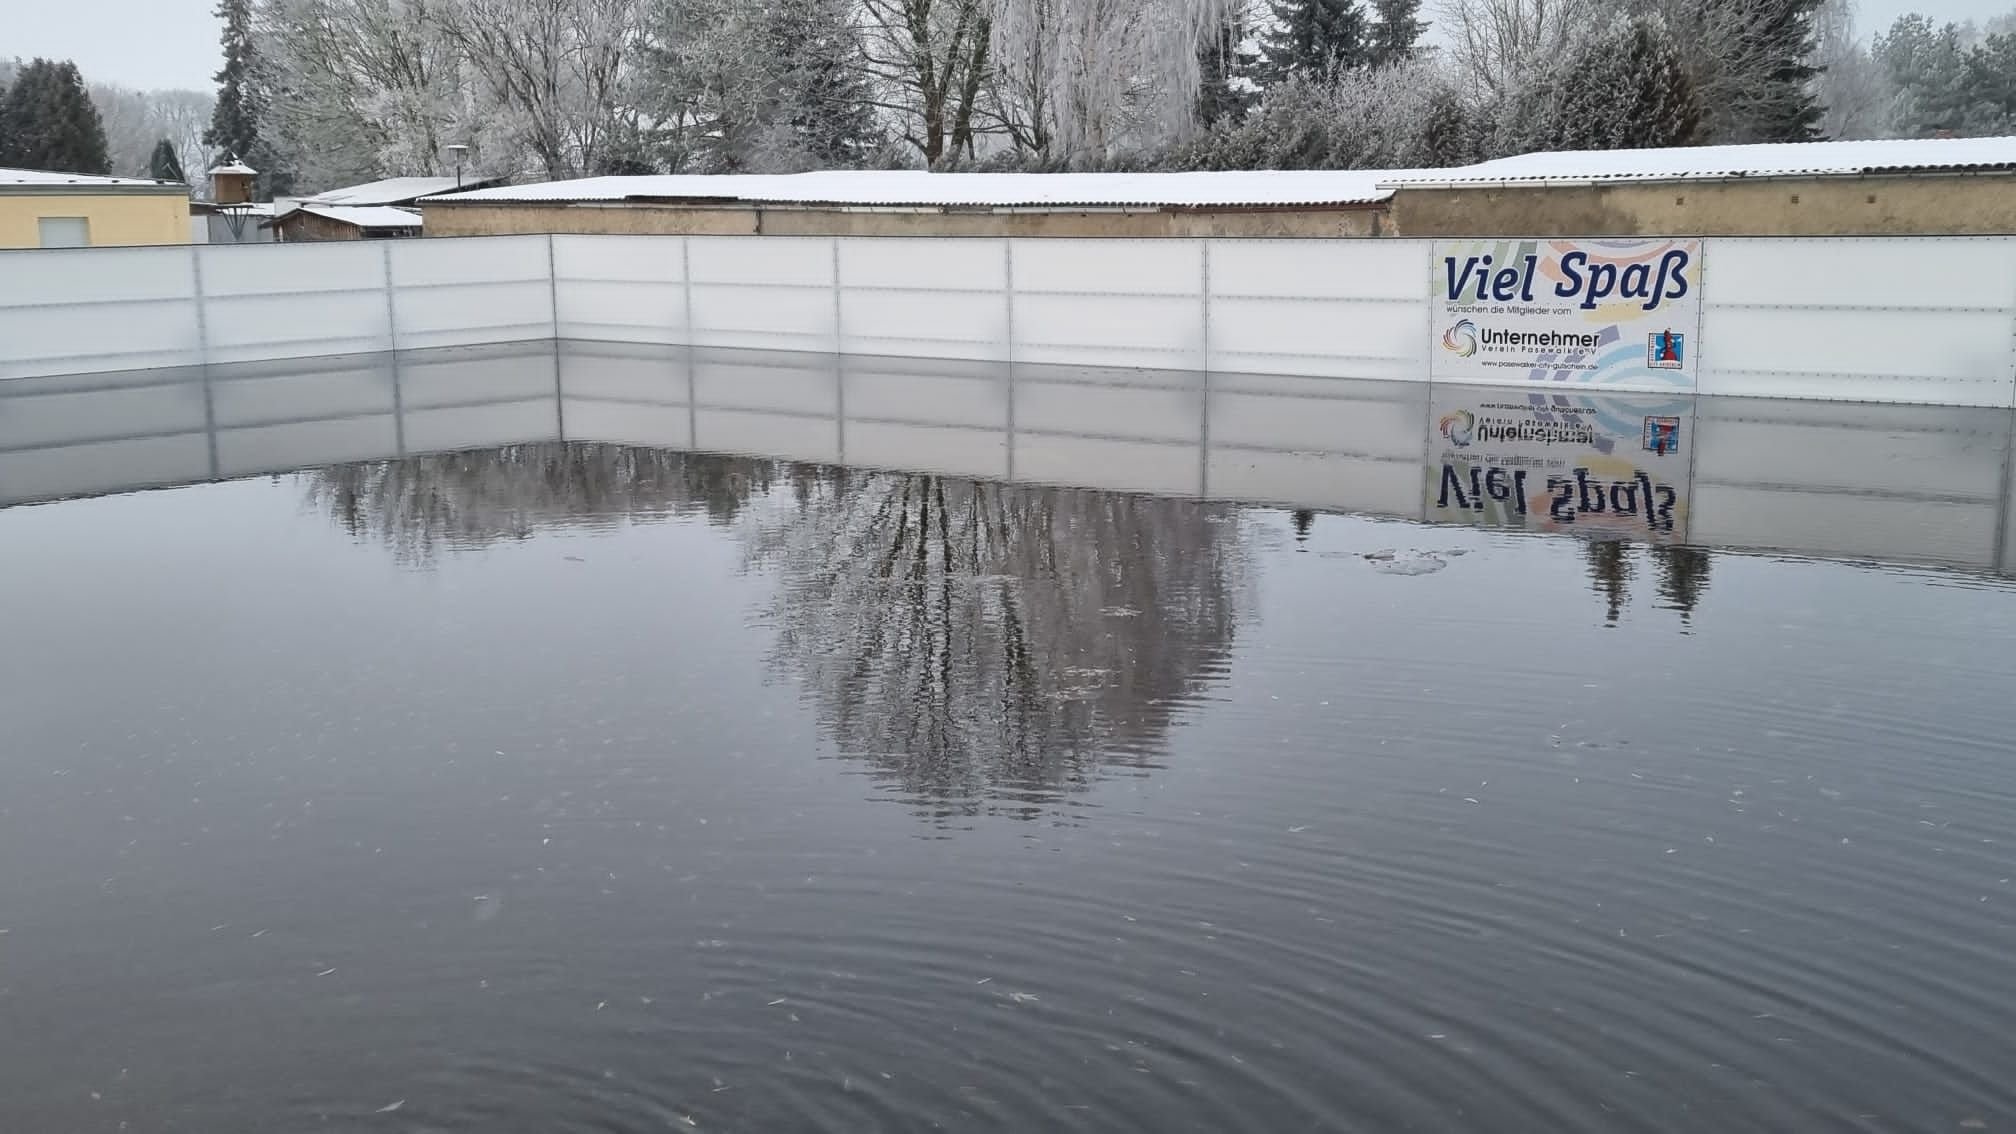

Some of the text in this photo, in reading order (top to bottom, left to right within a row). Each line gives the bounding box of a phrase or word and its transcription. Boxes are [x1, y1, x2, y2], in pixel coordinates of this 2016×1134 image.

[1445, 249, 1689, 311] Viel Spaß
[1446, 304, 1571, 317] wünschen die Mitglieder vom
[1481, 328, 1600, 347] Unternehmer
[1482, 345, 1516, 353] Verein
[1521, 346, 1572, 354] Pasewalk
